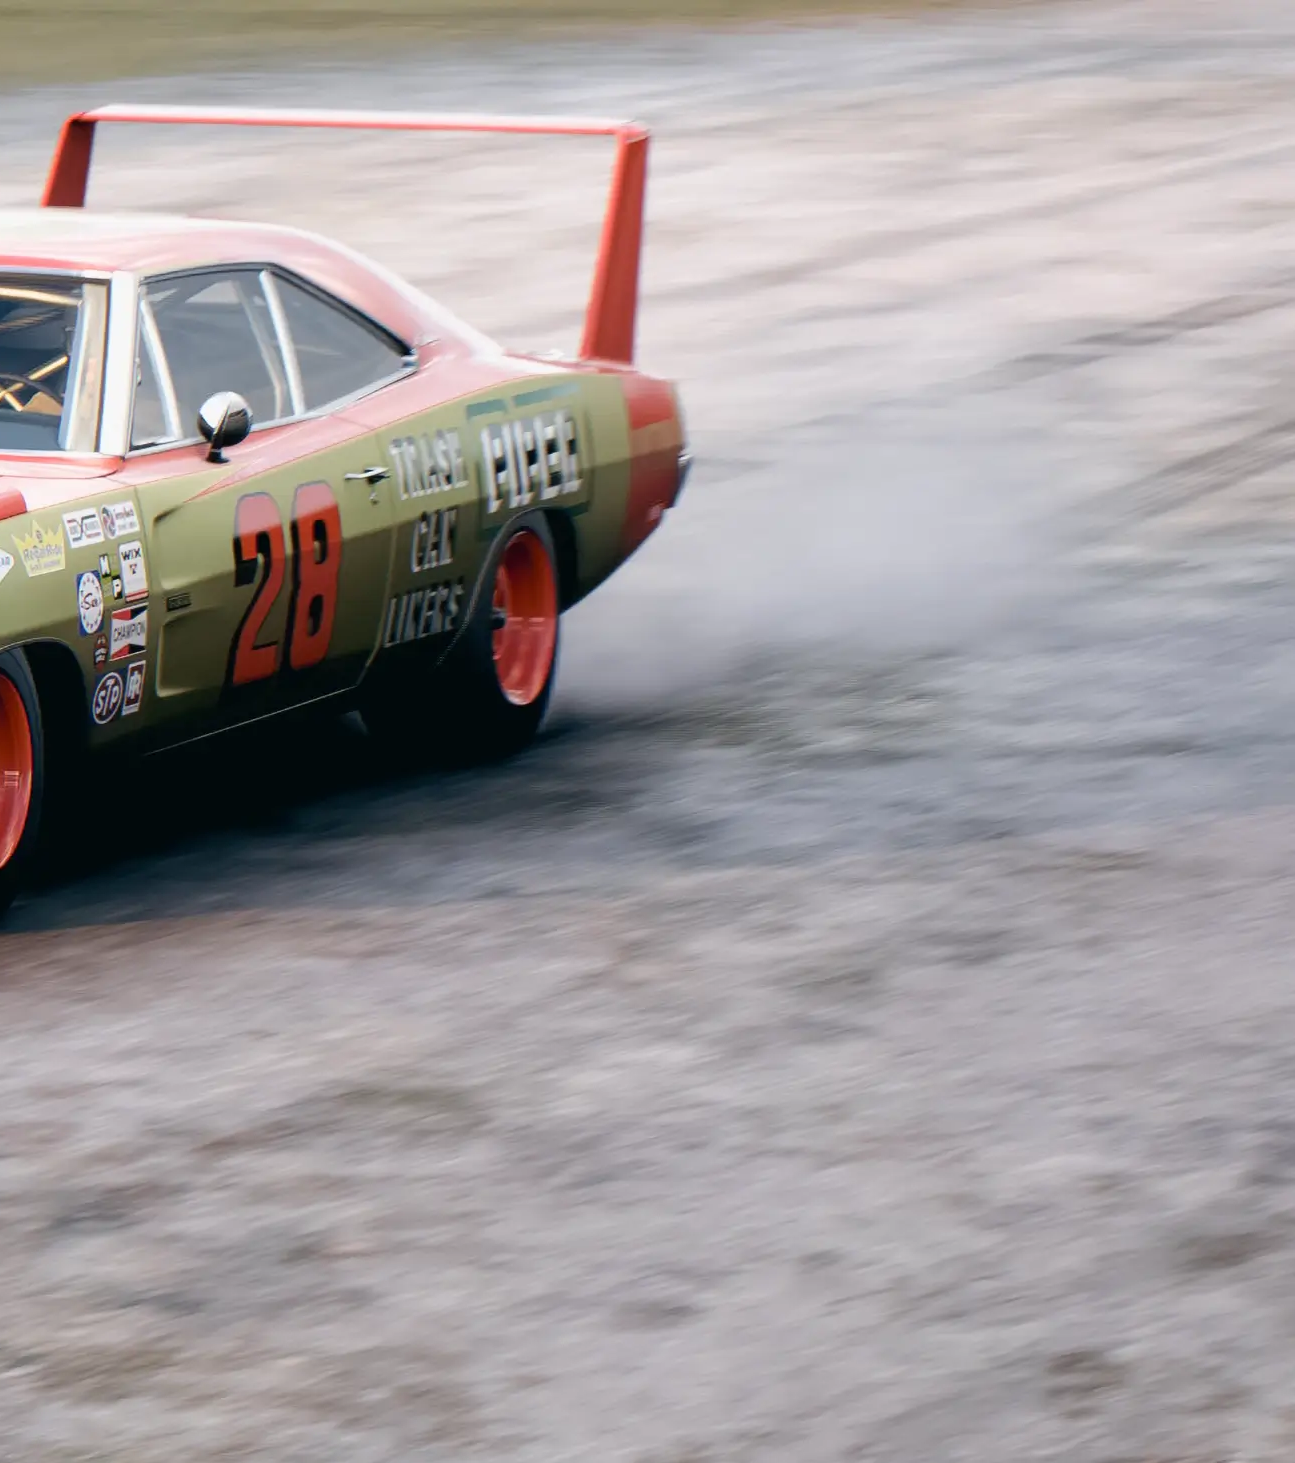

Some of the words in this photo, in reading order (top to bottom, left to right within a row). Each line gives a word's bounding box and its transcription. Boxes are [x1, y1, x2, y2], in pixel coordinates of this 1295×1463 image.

[121, 548, 142, 561] WIX
[232, 480, 343, 686] 28
[95, 678, 120, 716] STP
